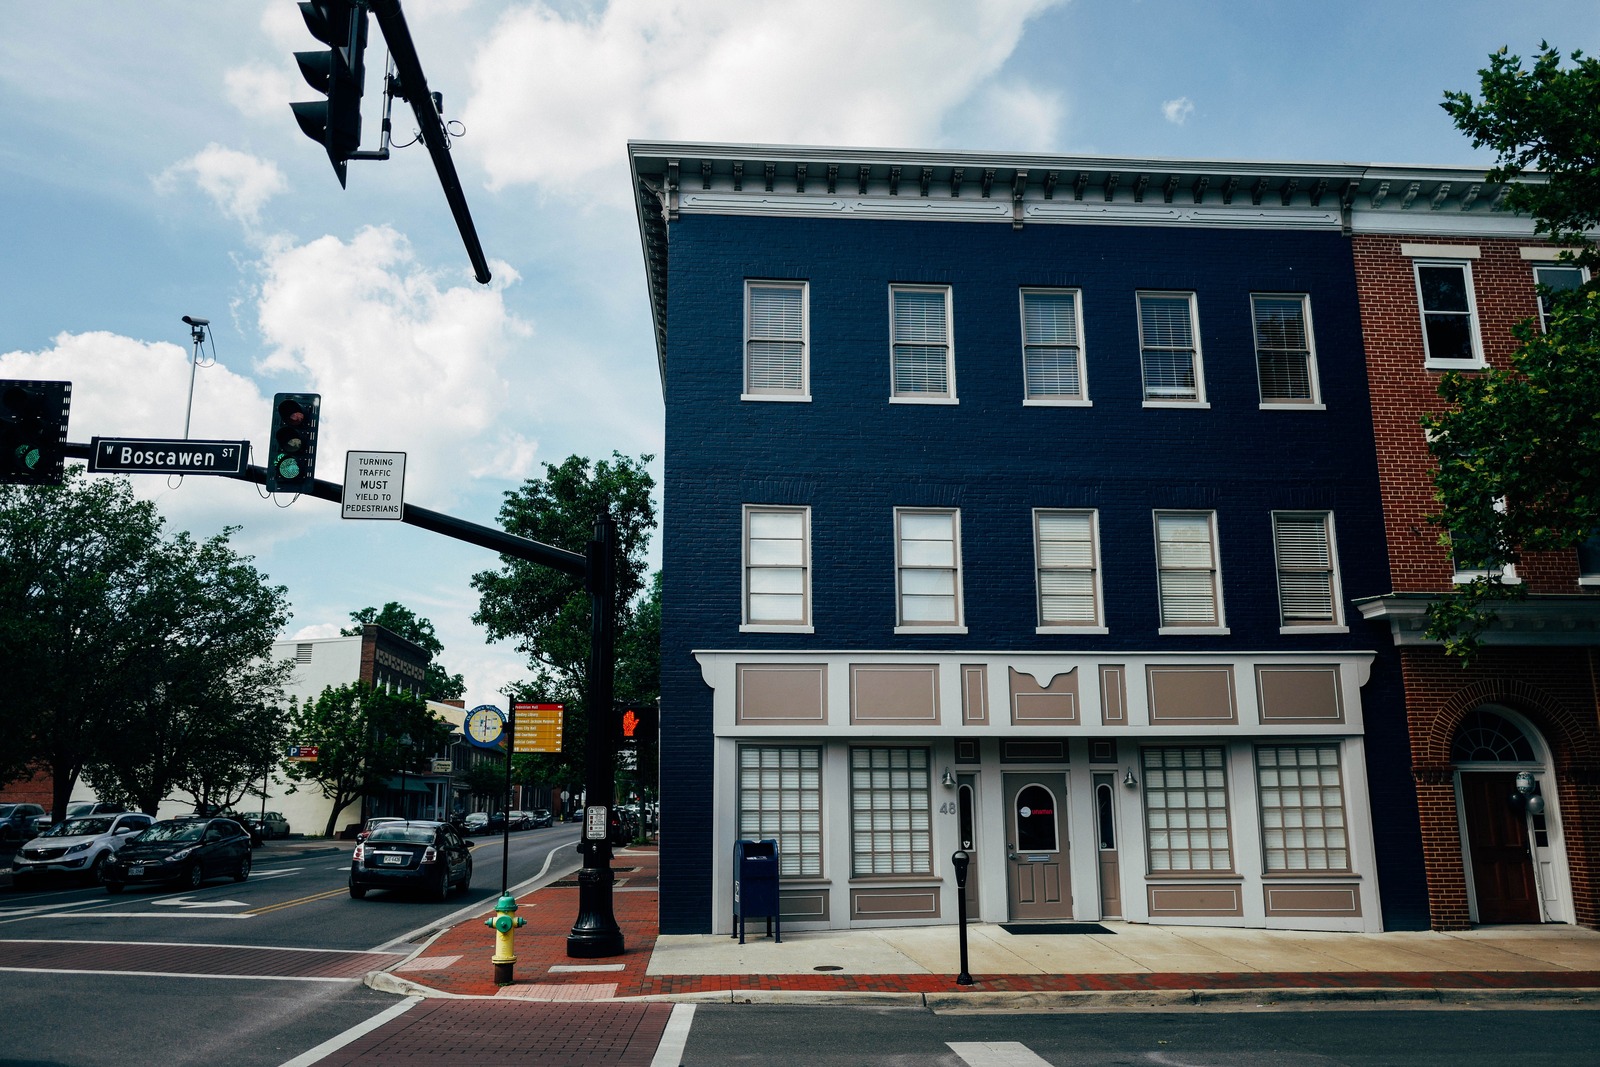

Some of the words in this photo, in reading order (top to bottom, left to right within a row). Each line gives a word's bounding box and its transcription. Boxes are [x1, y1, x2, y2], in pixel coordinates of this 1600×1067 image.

[106, 445, 114, 454] W
[120, 446, 215, 466] Boscawen
[222, 448, 234, 458] ST
[359, 458, 393, 466] TURNING
[360, 480, 388, 489] MUST
[355, 493, 379, 501] YIELD
[346, 504, 399, 513] PEDESTRIANS
[290, 747, 298, 756] P
[939, 802, 956, 815] 48
